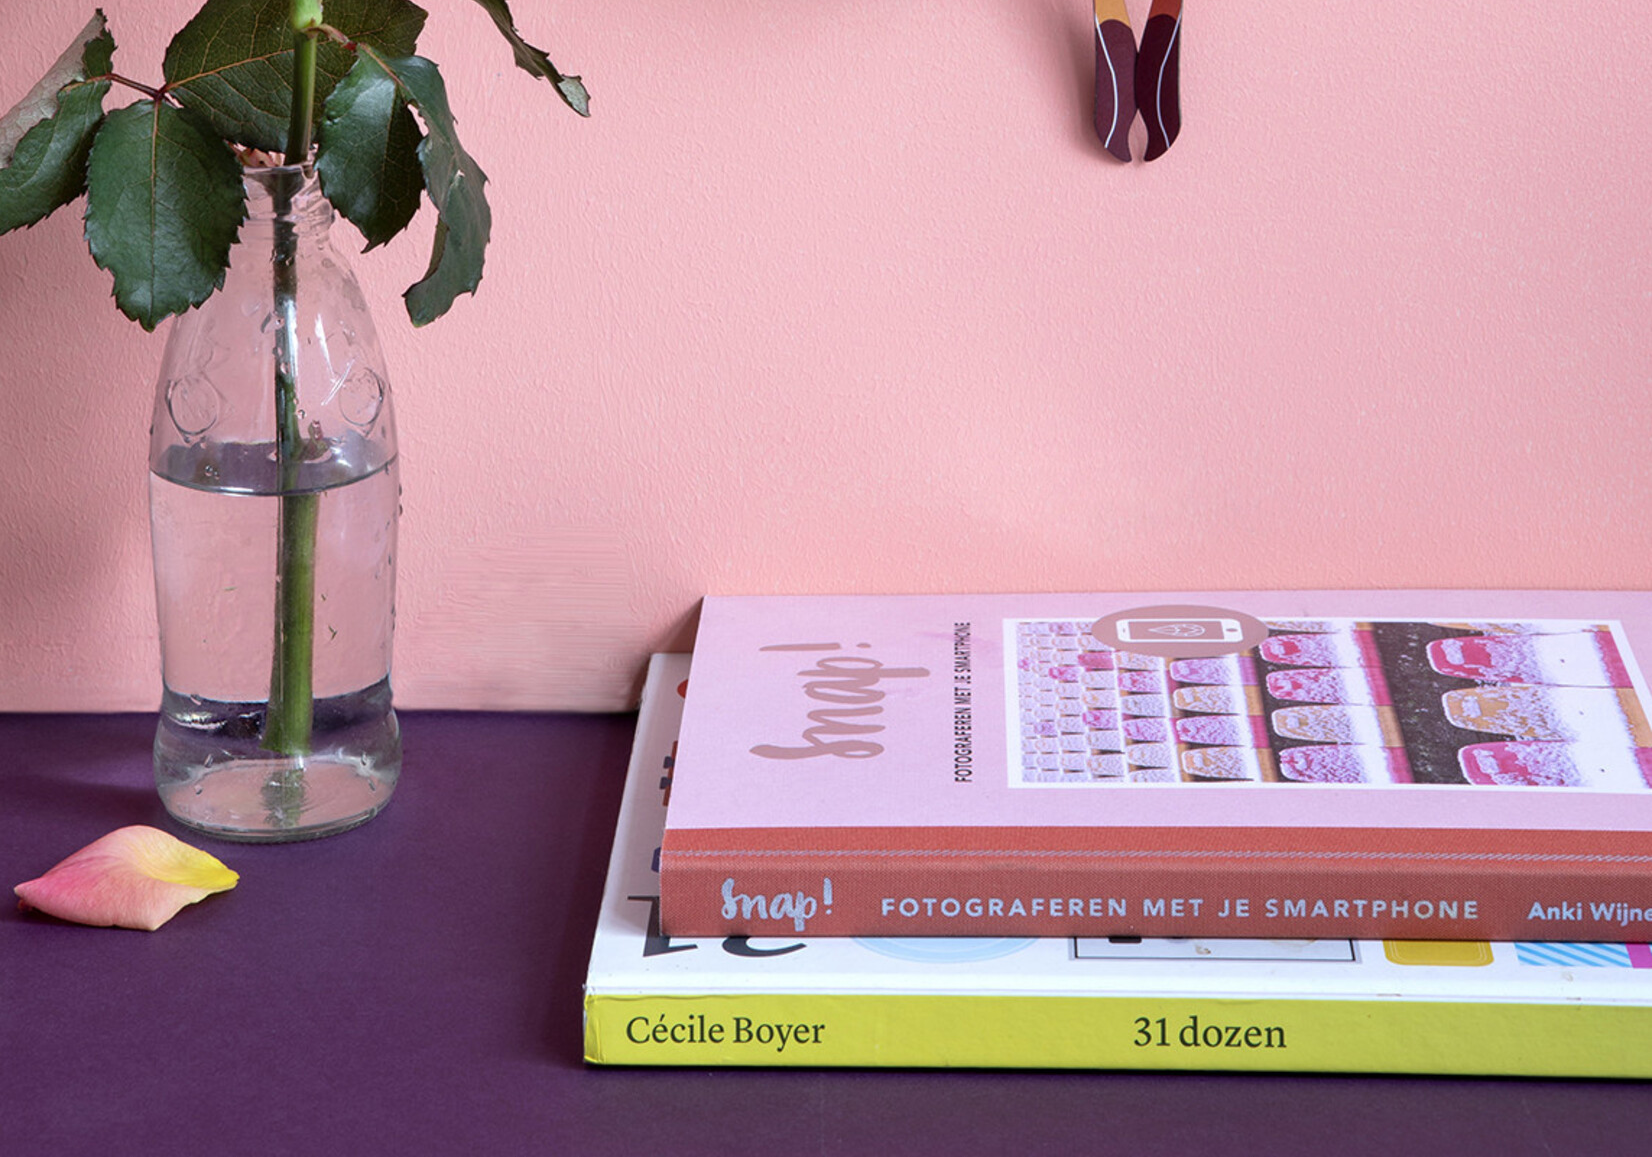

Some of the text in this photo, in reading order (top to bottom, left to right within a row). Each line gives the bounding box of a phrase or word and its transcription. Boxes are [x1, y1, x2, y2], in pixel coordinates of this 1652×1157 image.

[954, 622, 973, 782] FOTOGRAFEREN MET JE SMARTPHONE
[881, 898, 1480, 920] FOTOGRAFEREN MET JE SMARTPHONE
[1527, 901, 1583, 921] Anki
[626, 1014, 825, 1052] Cécile Boyer
[1134, 1015, 1287, 1048] 31 dozen
